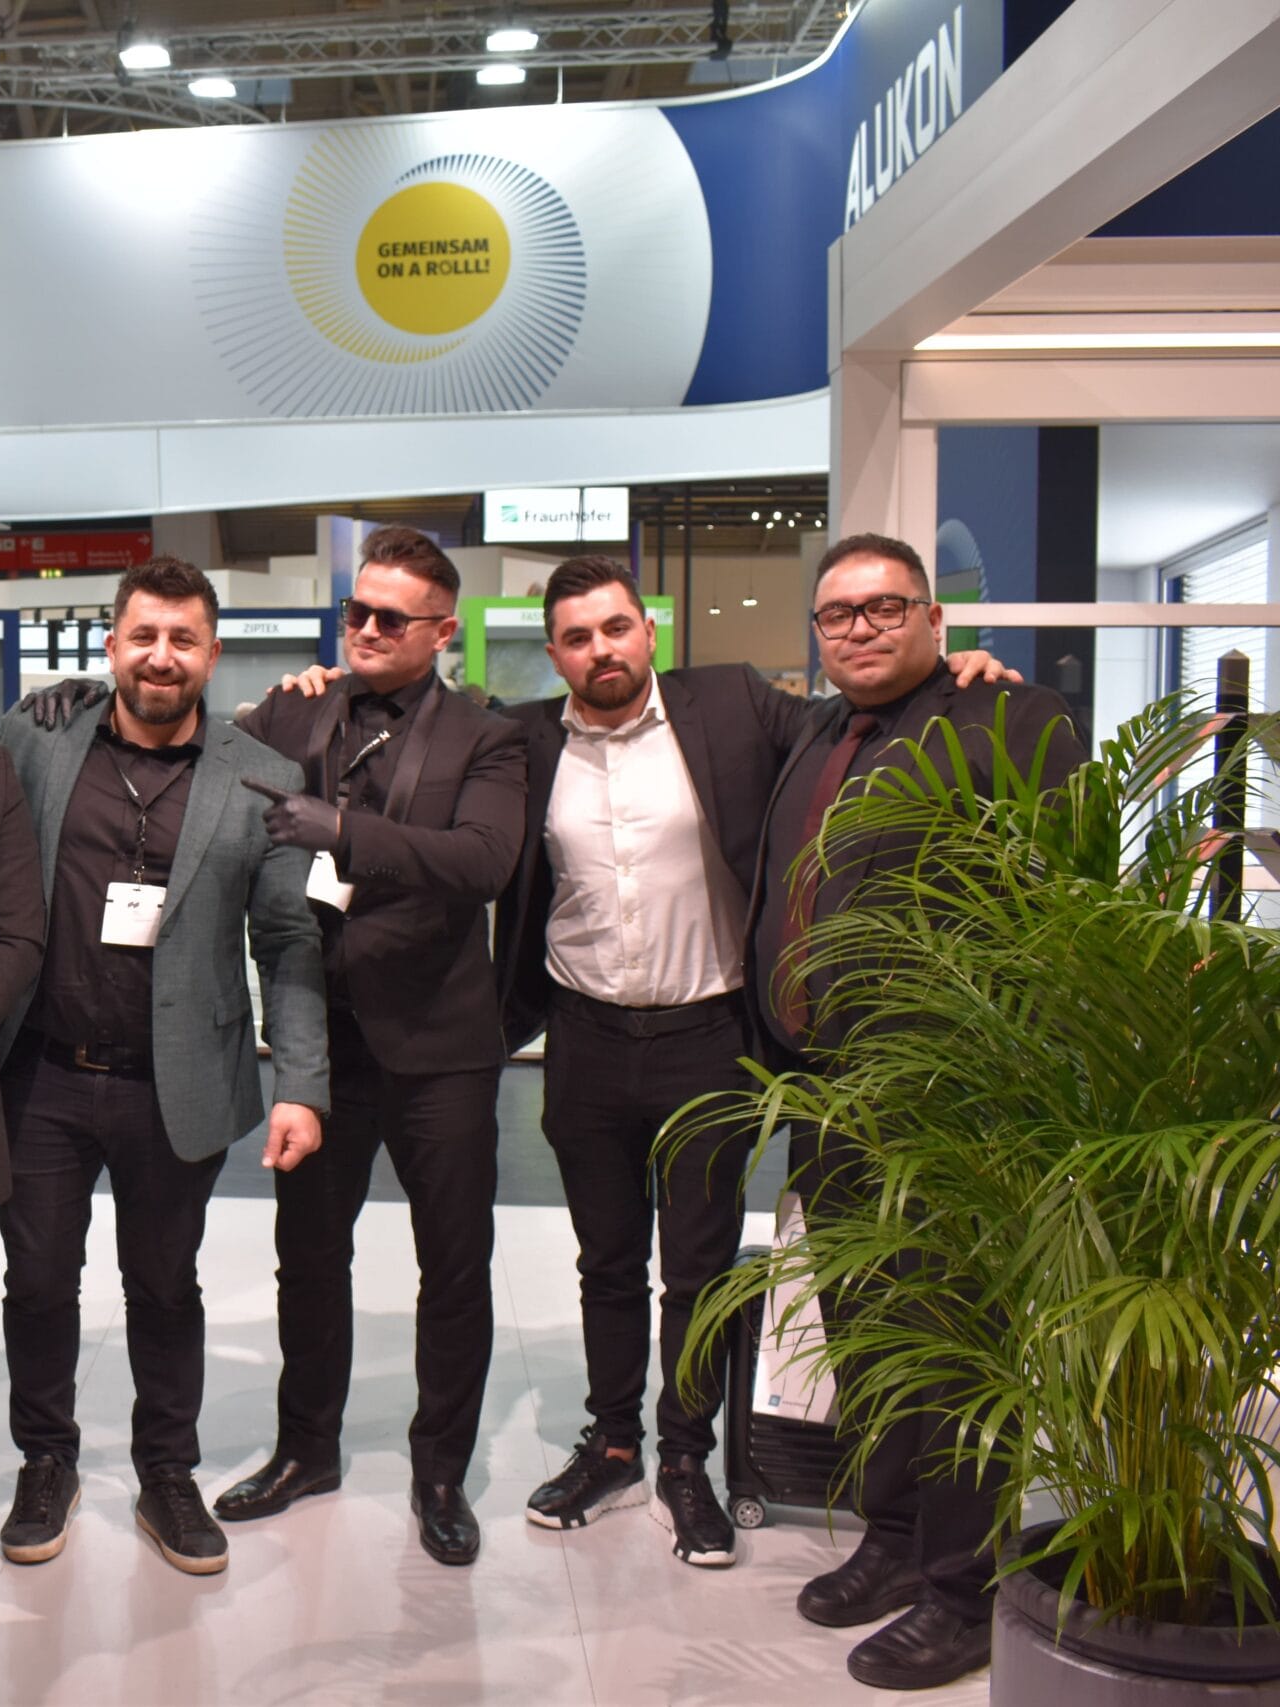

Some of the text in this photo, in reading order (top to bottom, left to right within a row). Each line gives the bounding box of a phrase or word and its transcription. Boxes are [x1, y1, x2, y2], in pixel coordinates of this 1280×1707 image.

[843, 3, 963, 234] ALUKON
[377, 238, 490, 258] GEMEINSAM
[377, 258, 490, 278] ON A ROLLL!
[524, 509, 612, 523] Fraunhofer
